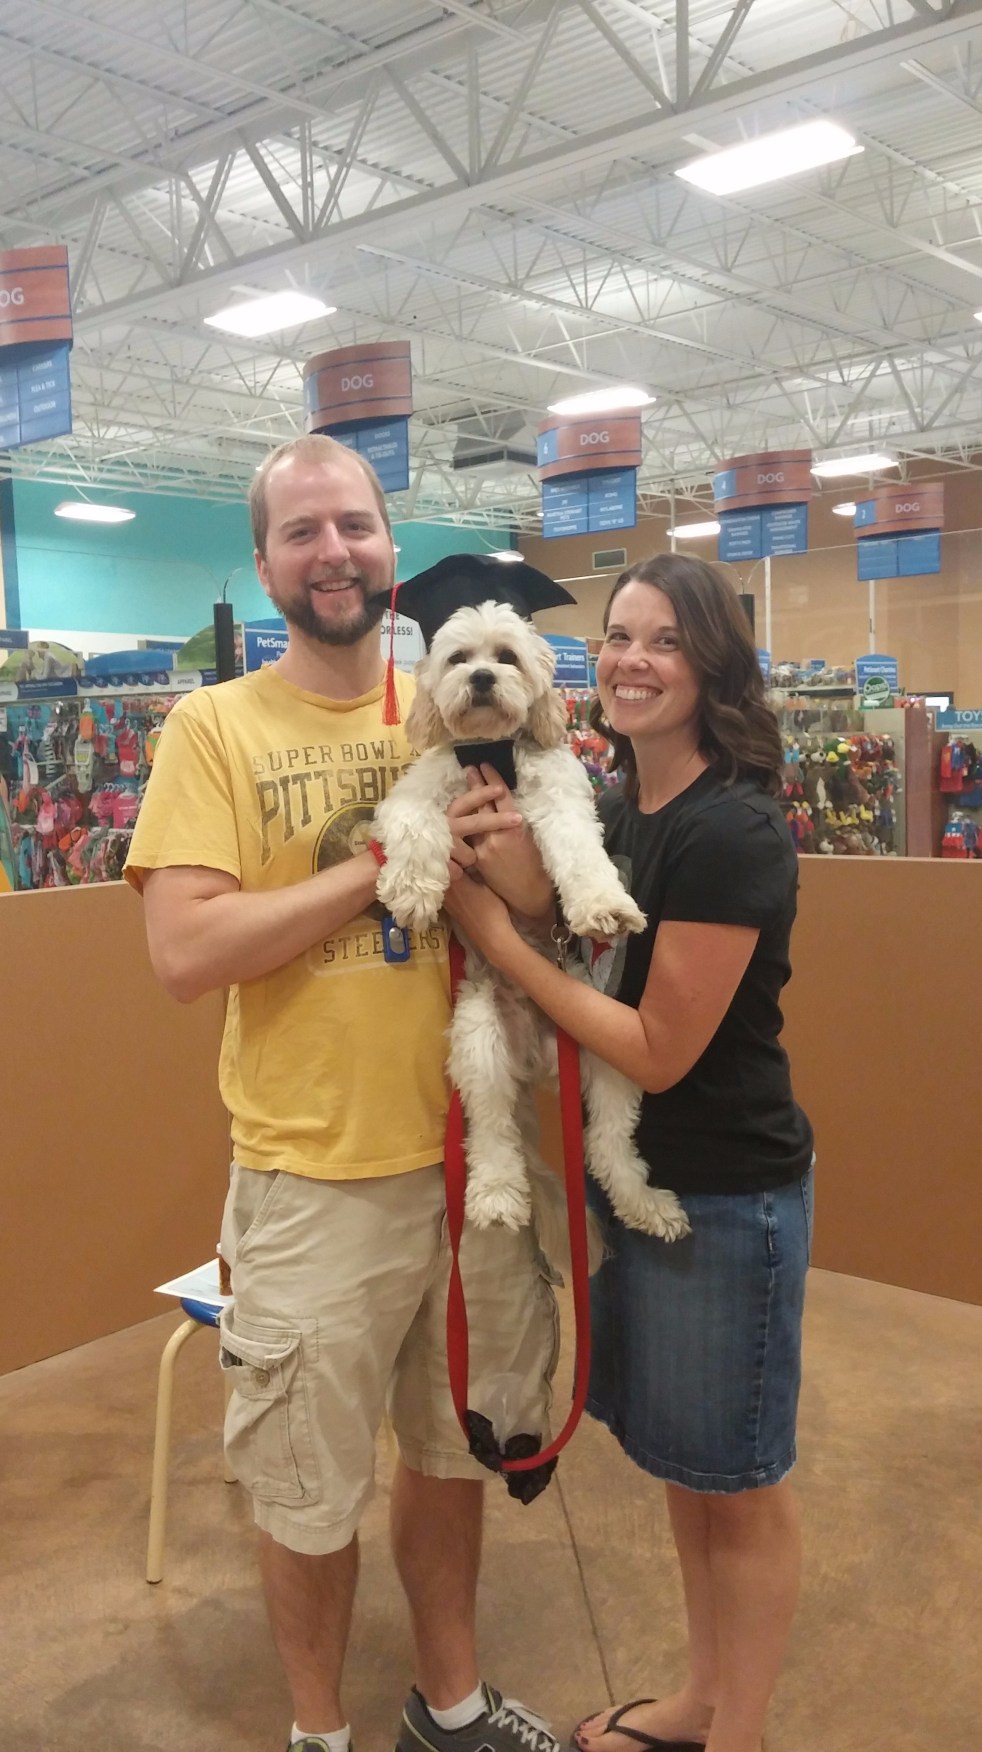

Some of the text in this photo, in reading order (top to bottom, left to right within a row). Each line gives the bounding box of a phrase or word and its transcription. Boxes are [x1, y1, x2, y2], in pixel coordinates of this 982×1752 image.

[0, 287, 24, 307] OG
[341, 374, 374, 391] DOG
[580, 431, 610, 445] DOG
[757, 472, 784, 484] DOG
[895, 502, 920, 513] DOG
[256, 636, 289, 648] PetSma
[954, 711, 982, 722] TOY
[252, 740, 400, 775] SUPER BOWL
[256, 762, 414, 866] PITTSBU
[323, 926, 444, 963] STEEERS
